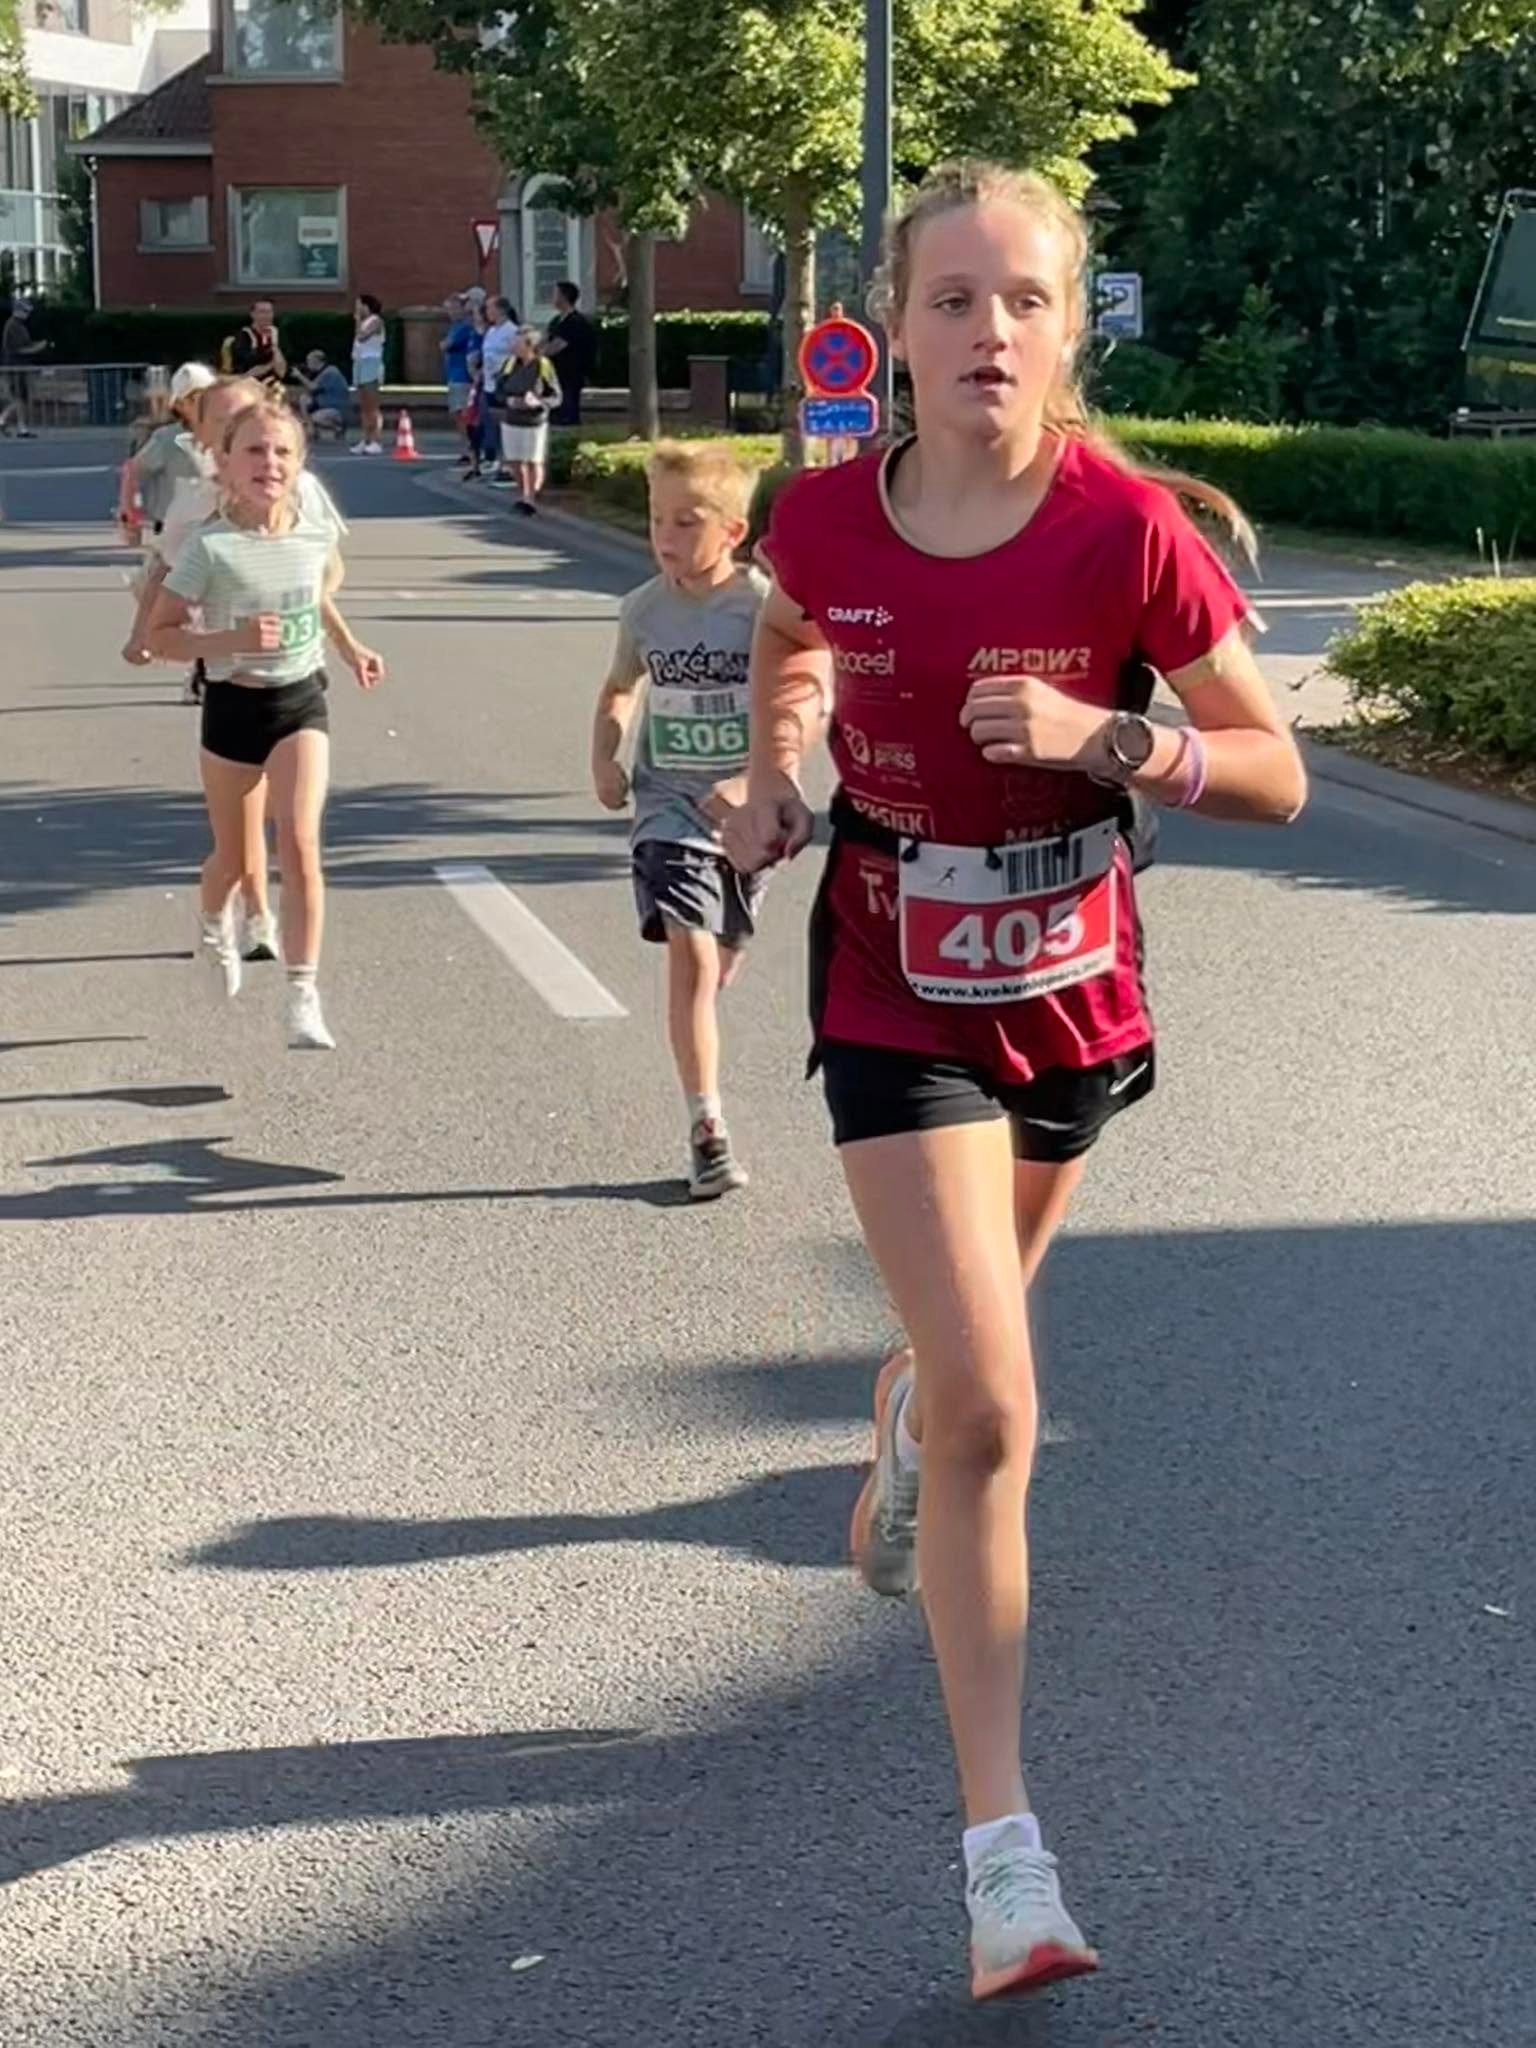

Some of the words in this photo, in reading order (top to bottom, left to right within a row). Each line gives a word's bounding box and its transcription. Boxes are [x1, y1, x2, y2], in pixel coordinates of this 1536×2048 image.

[280, 613, 314, 646] 03
[827, 607, 875, 624] CRAFT
[967, 645, 1092, 673] MPOWR
[666, 721, 745, 755] 306
[938, 895, 1085, 972] 405
